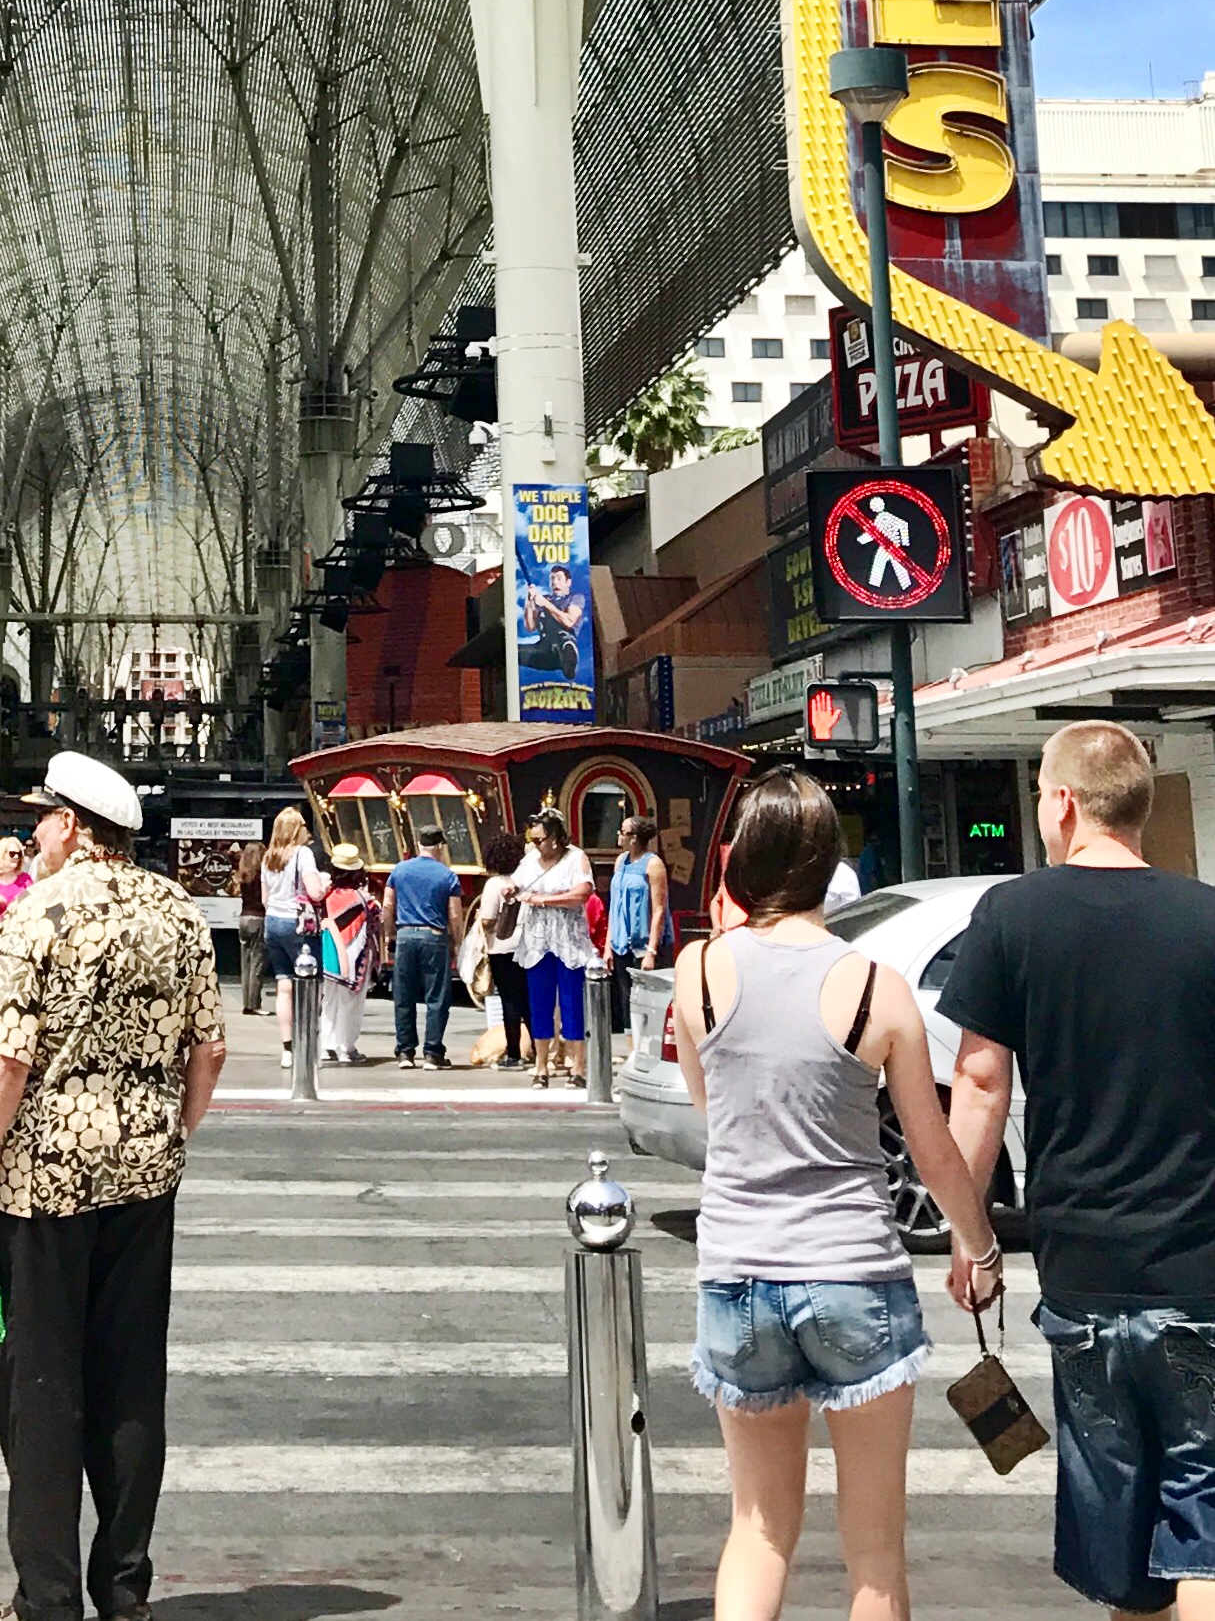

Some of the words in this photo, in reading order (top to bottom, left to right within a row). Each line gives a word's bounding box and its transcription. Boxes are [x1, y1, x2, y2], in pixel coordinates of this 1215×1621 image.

[519, 490, 538, 503] WE
[541, 490, 581, 503] TRIPLE
[532, 504, 569, 523] DOG
[528, 524, 575, 543] DARE
[533, 544, 570, 563] YOU
[195, 829, 213, 837] VEGAS
[970, 823, 1005, 838] ATM
